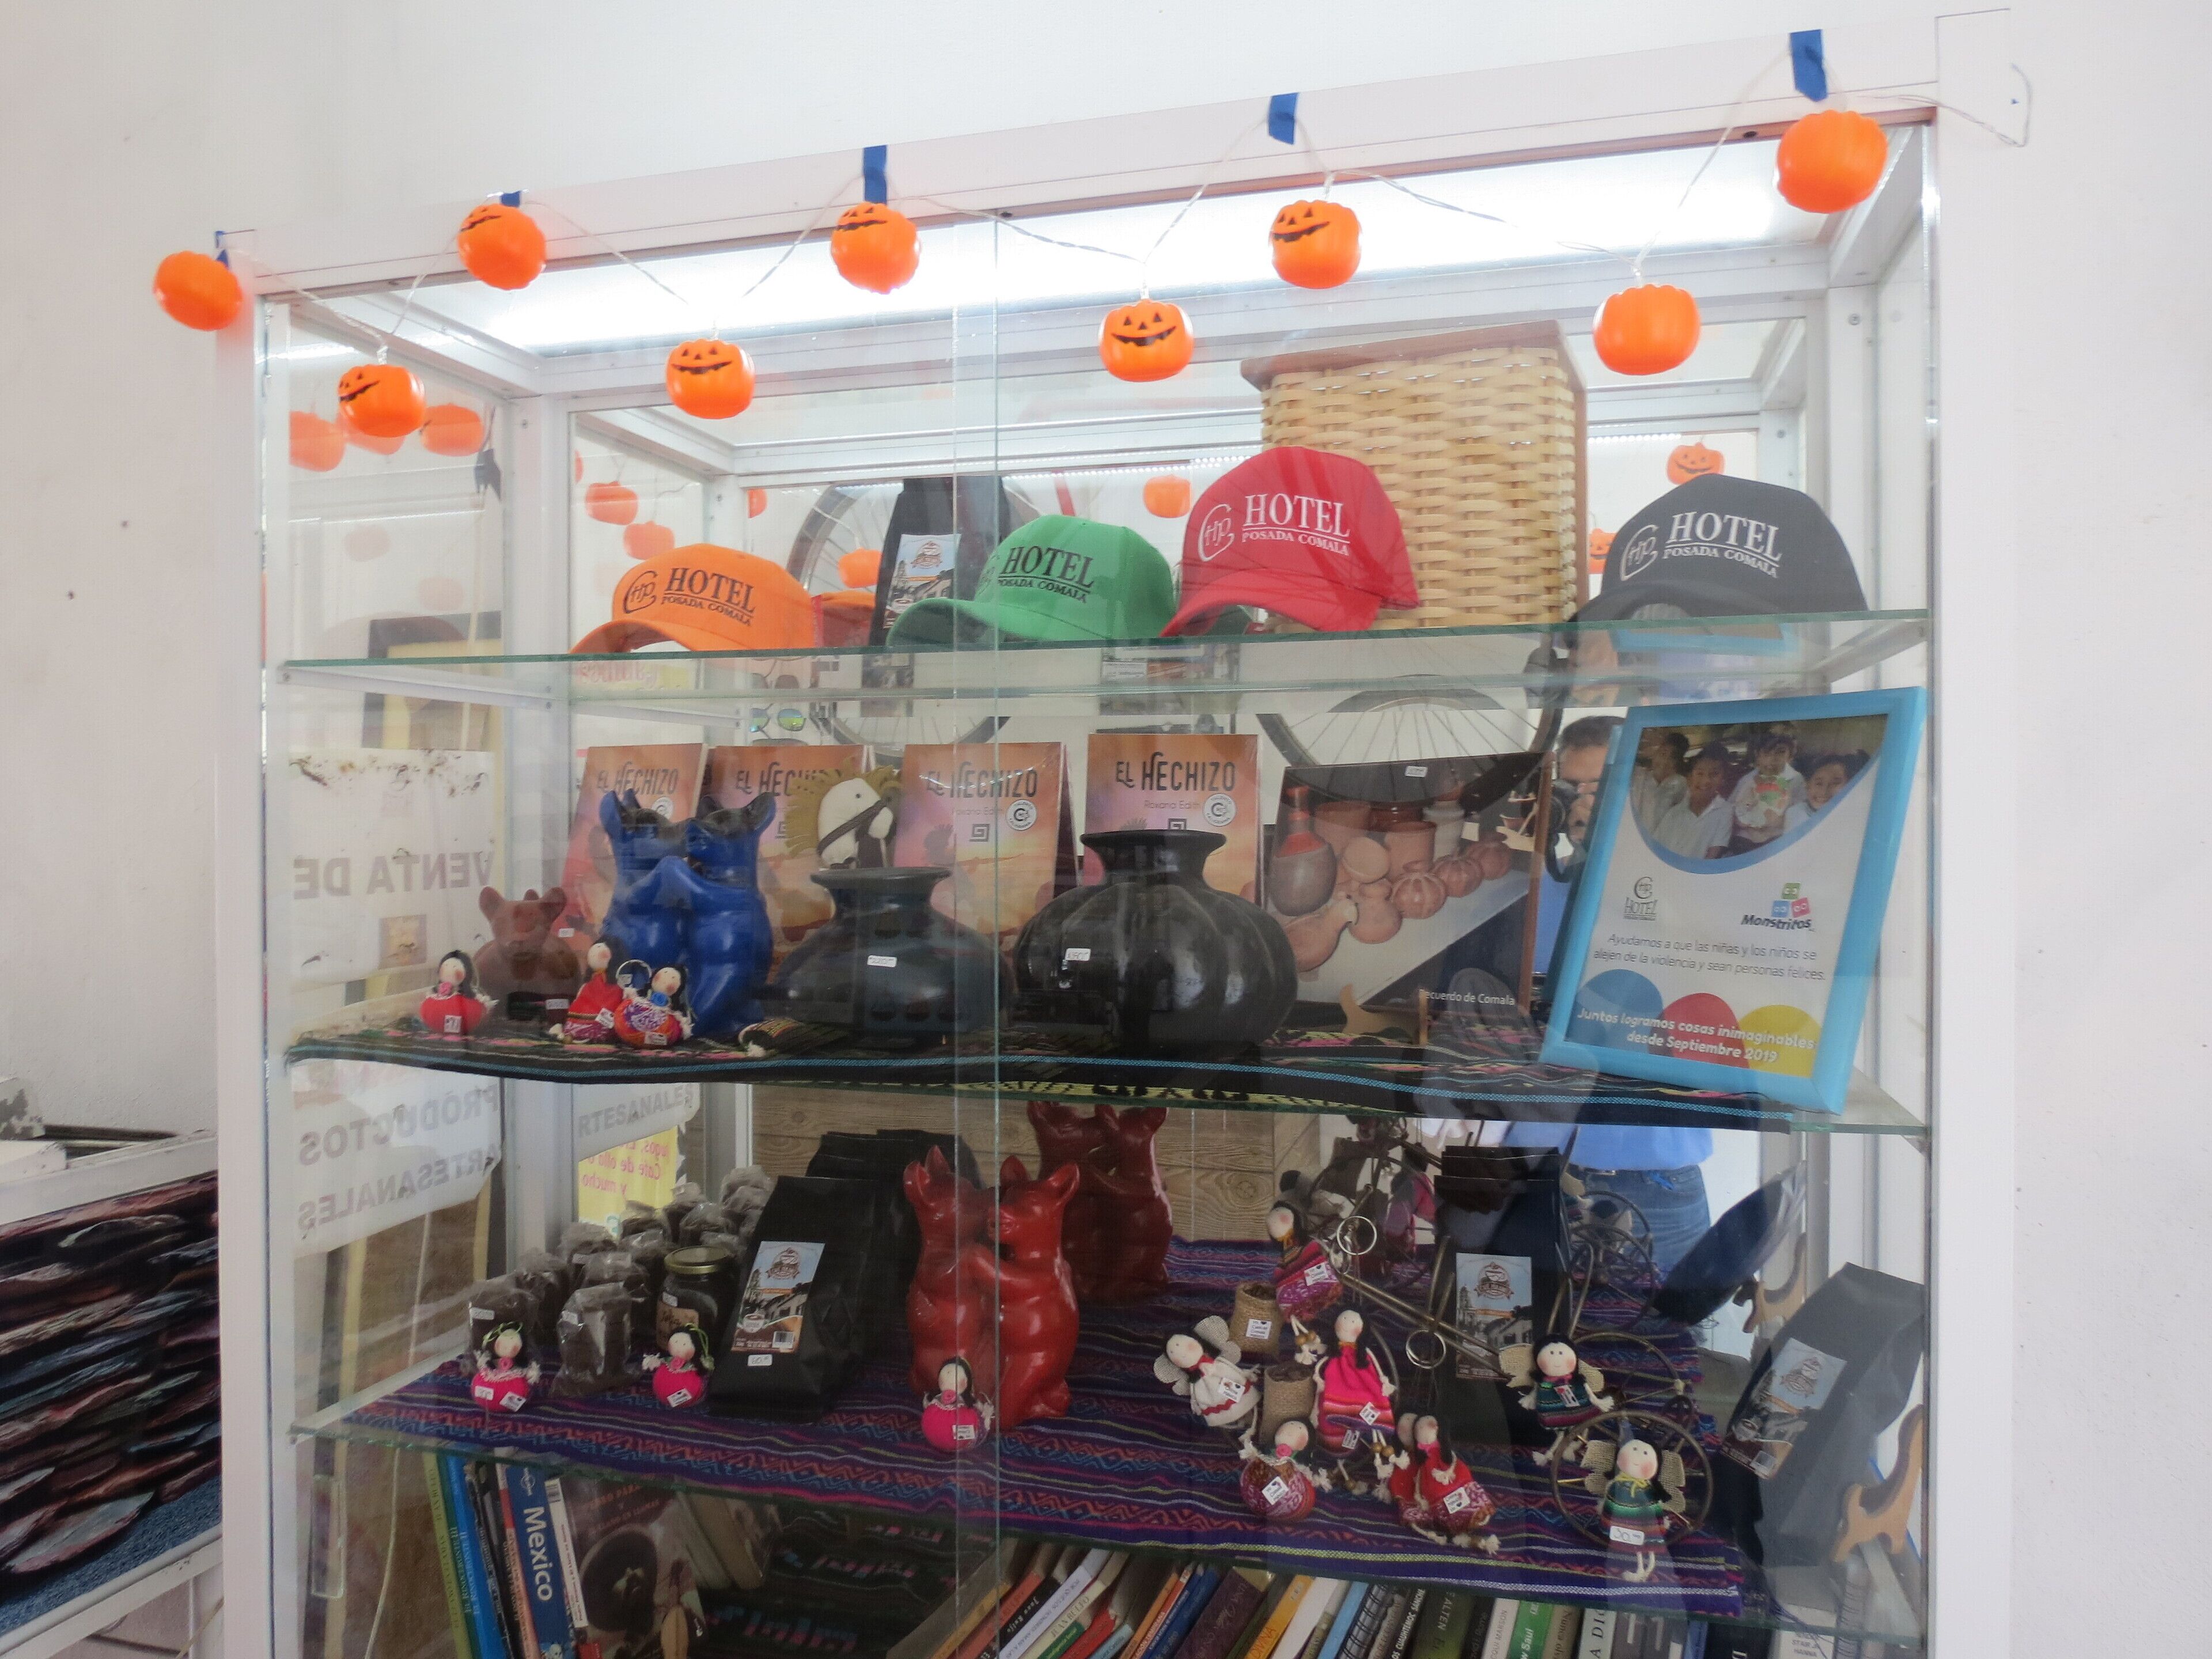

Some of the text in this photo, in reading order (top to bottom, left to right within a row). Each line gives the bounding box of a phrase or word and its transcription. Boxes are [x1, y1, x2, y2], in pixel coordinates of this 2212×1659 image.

[1243, 493, 1350, 537] HOTEL
[1241, 530, 1350, 556] POSADA COMALA
[1666, 511, 1783, 562] HOTEL
[1000, 546, 1094, 588] HOTEL
[1662, 547, 1778, 578] POSADA COMALA
[664, 567, 755, 613] HOTEL
[998, 578, 1087, 604] POSADA COMALA
[661, 596, 752, 626] POSADA COMALA
[612, 761, 679, 796] HECHIZO
[950, 761, 1038, 798] HECHIZO
[1115, 751, 1236, 791] EL HECHIZO
[1623, 897, 1658, 915] HOTEL
[1740, 914, 1812, 930] Monstritos
[1593, 948, 1622, 961] alejen
[1623, 951, 1637, 963] de
[1639, 952, 1649, 963] la
[1651, 954, 1696, 969] violencia
[1696, 961, 1705, 972] y
[1707, 961, 1732, 972] sean
[1734, 964, 1785, 977] personas
[1608, 934, 1817, 960] Ayudamos a que las niñas y los niños se
[1422, 990, 1516, 1006] ecuerdo de Comala
[1577, 1008, 1817, 1049] Juntos logramos cosas inimaginables
[1626, 1030, 1780, 1062] desde Septiembre 2019
[522, 1505, 553, 1601] Mexico
[1006, 1596, 1040, 1633] Juan Rulfo
[1437, 1597, 1454, 1631] ALTEN
[1521, 1628, 1535, 1652] Saul
